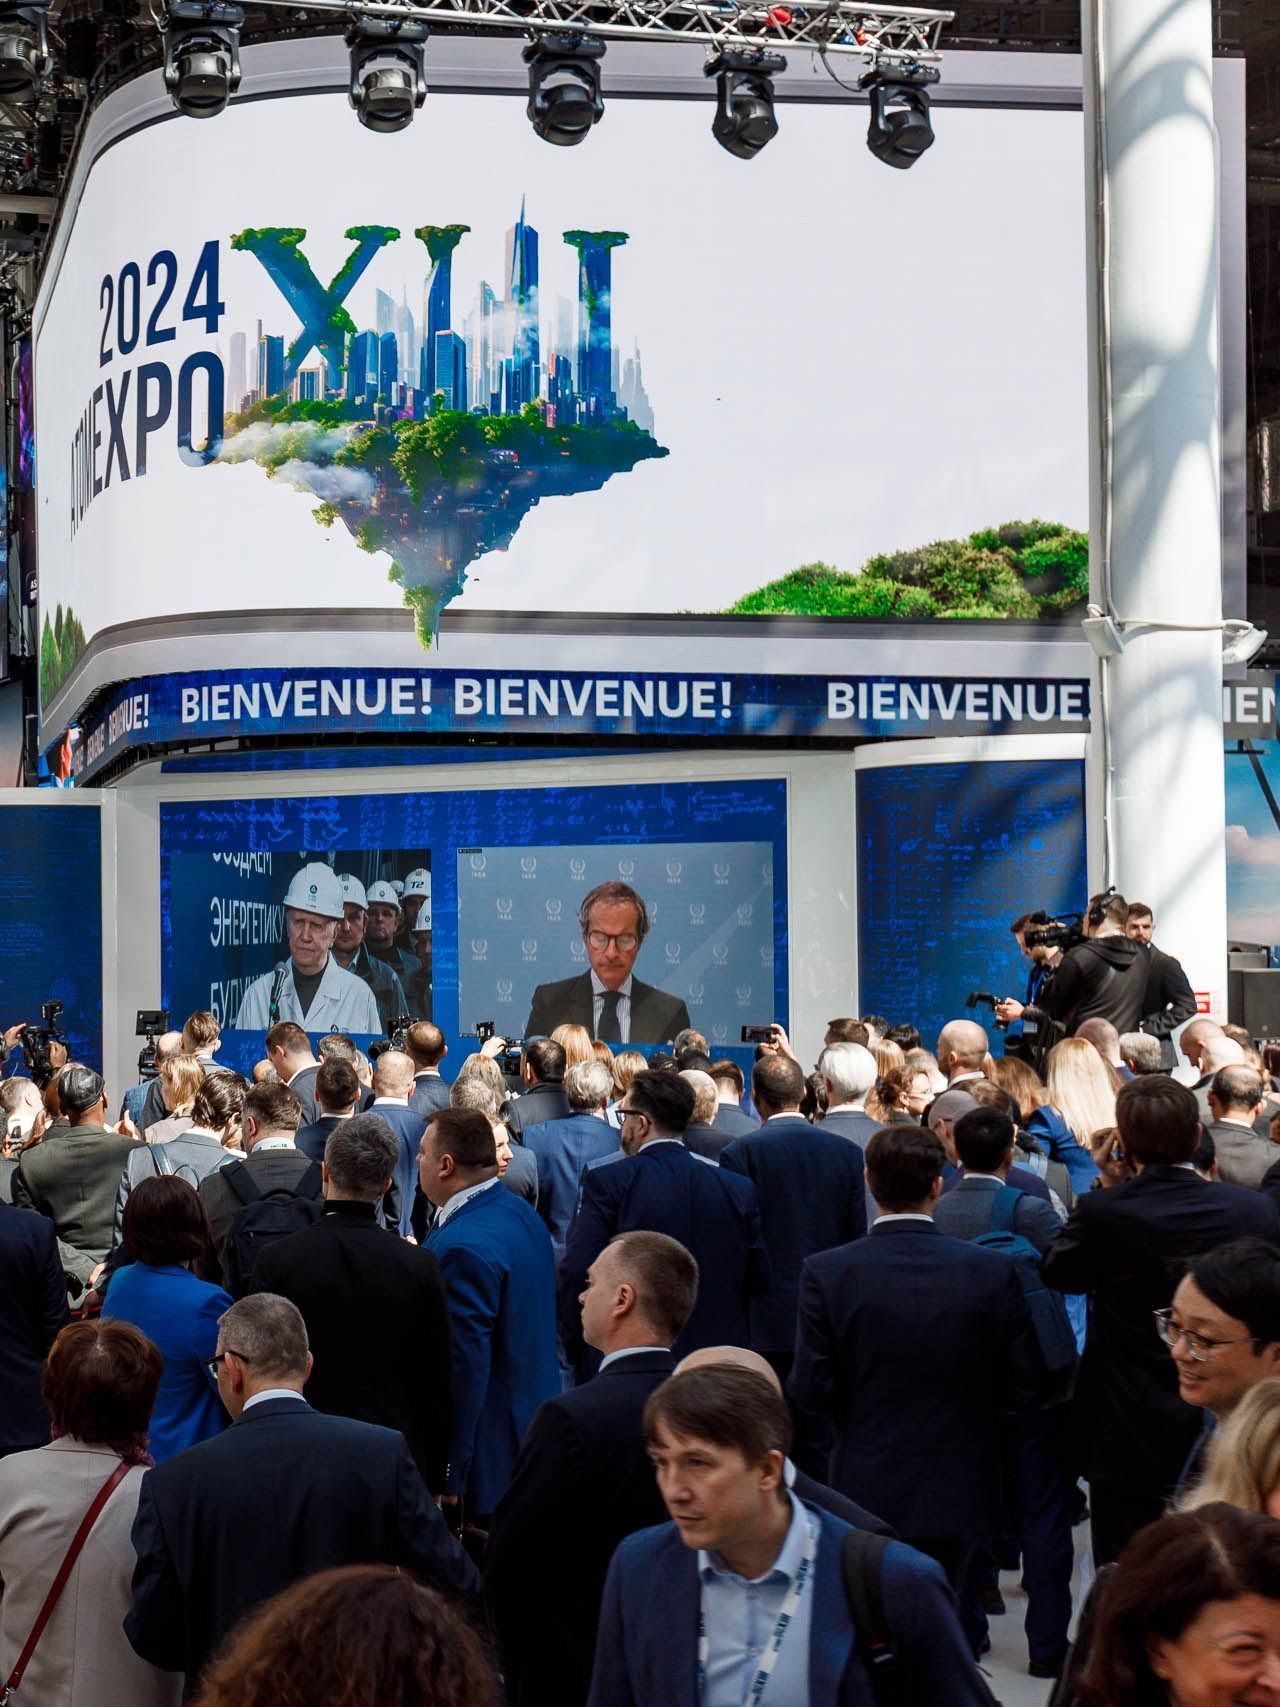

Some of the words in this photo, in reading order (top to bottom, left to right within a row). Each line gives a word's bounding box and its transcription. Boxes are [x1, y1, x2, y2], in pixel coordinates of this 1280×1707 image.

[100, 240, 225, 368] 2024
[70, 351, 225, 541] ATOMEXPO
[181, 678, 433, 724] BIENVENUE!
[454, 678, 732, 719] BIENVENUE!
[826, 682, 1092, 721] BIENVENUE
[210, 896, 286, 948] ЭНЕРГЕТИКУ
